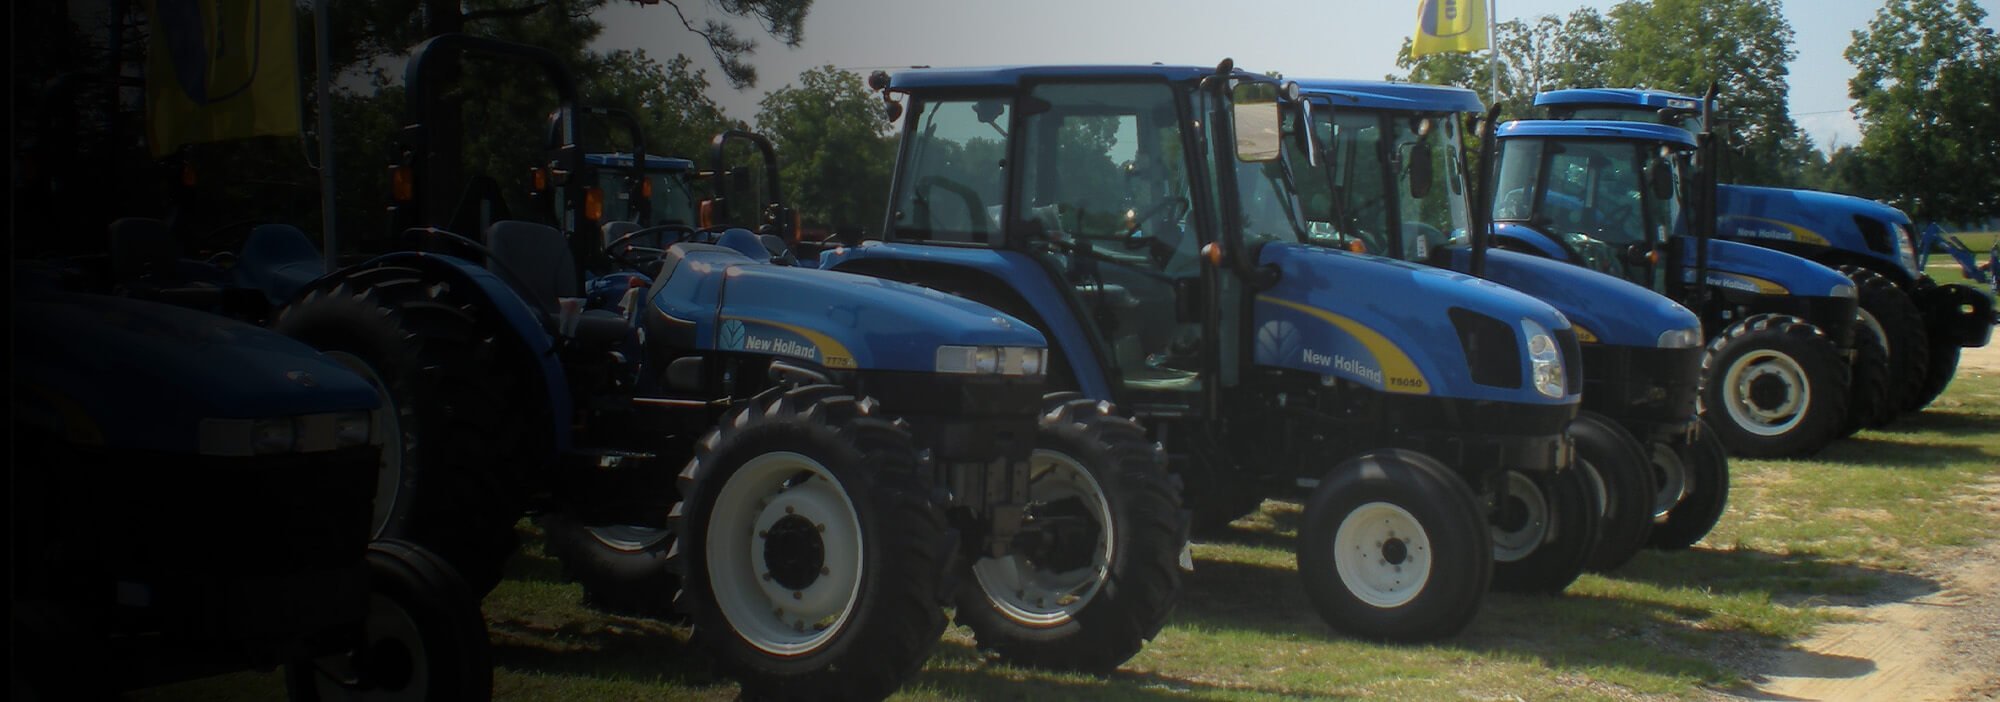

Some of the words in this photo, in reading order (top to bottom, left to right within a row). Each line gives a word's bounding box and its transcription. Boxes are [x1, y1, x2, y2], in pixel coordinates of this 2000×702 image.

[745, 335, 772, 350] New
[772, 338, 816, 359] Holland
[1303, 348, 1332, 367] New
[1334, 354, 1381, 384] Holland
